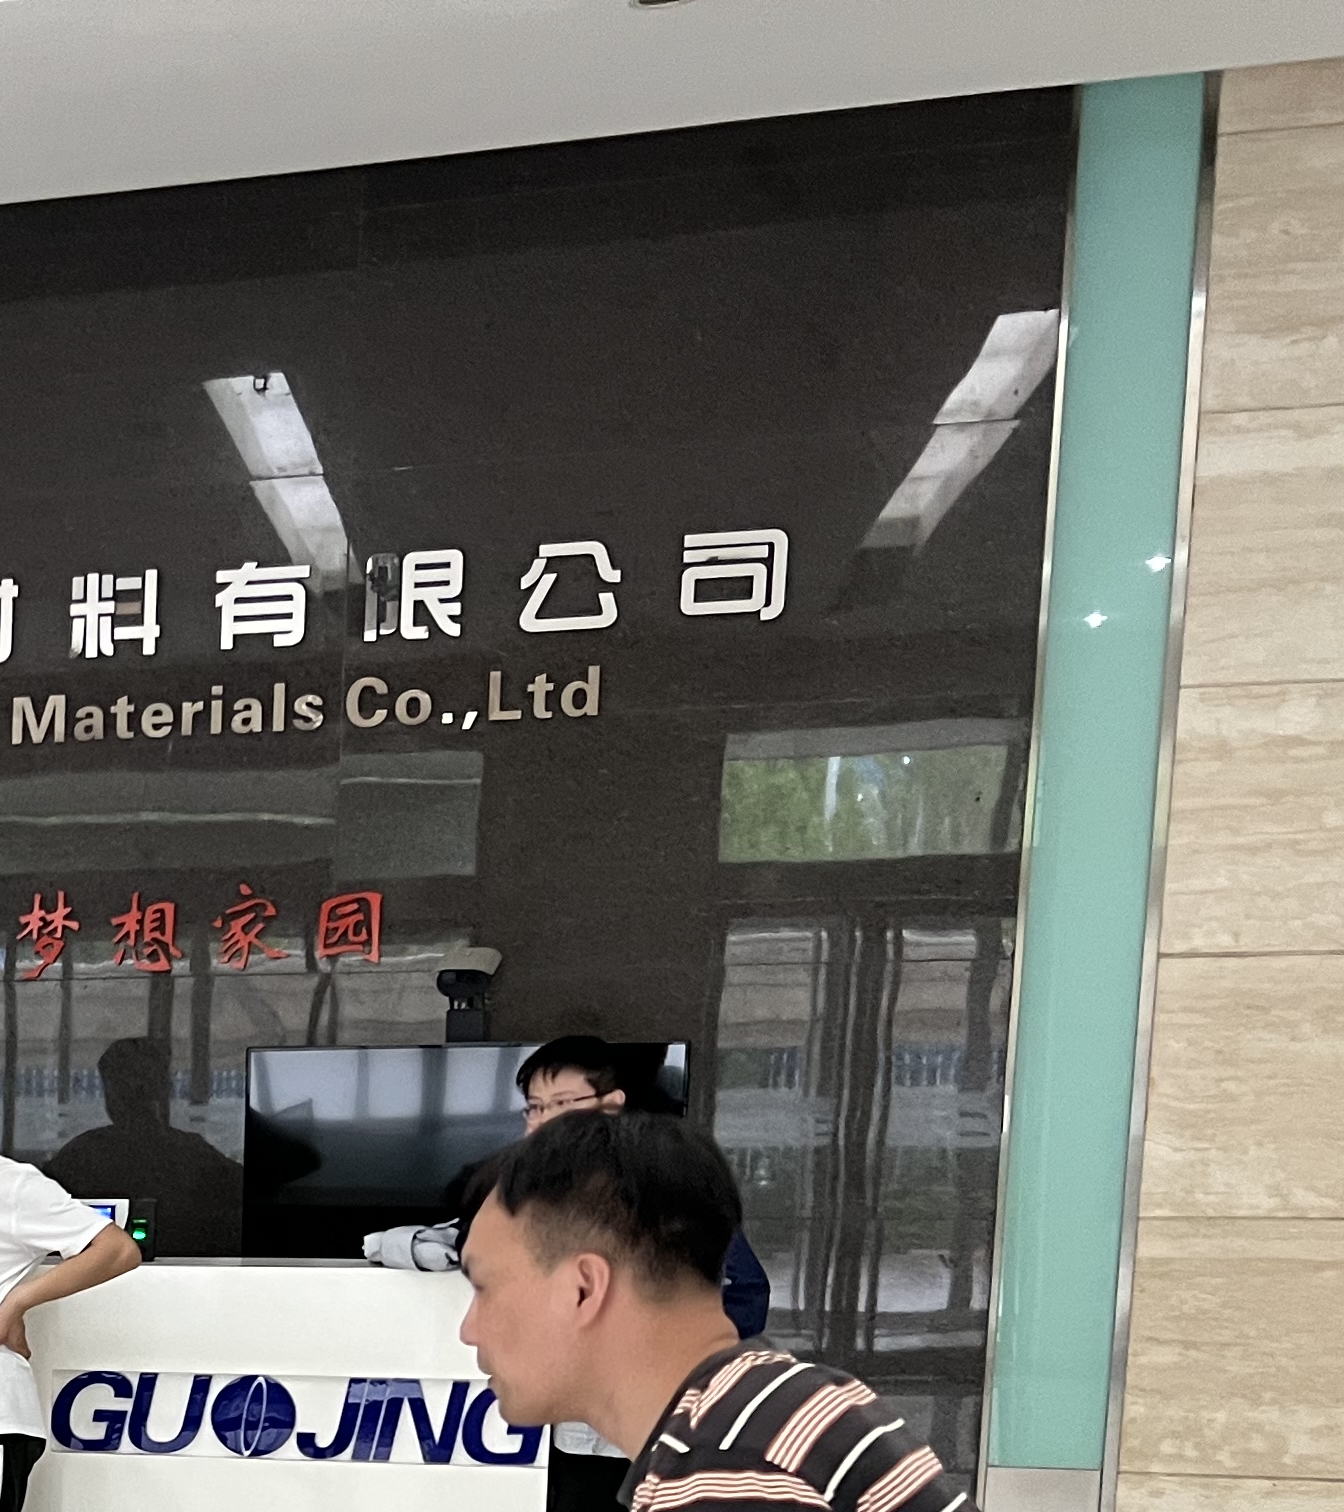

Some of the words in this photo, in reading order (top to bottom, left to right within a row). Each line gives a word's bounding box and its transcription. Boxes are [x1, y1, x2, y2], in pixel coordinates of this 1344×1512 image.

[9, 682, 325, 748] Materials
[344, 665, 601, 732] Co.,Ltd
[50, 1370, 544, 1466] GUOJING
